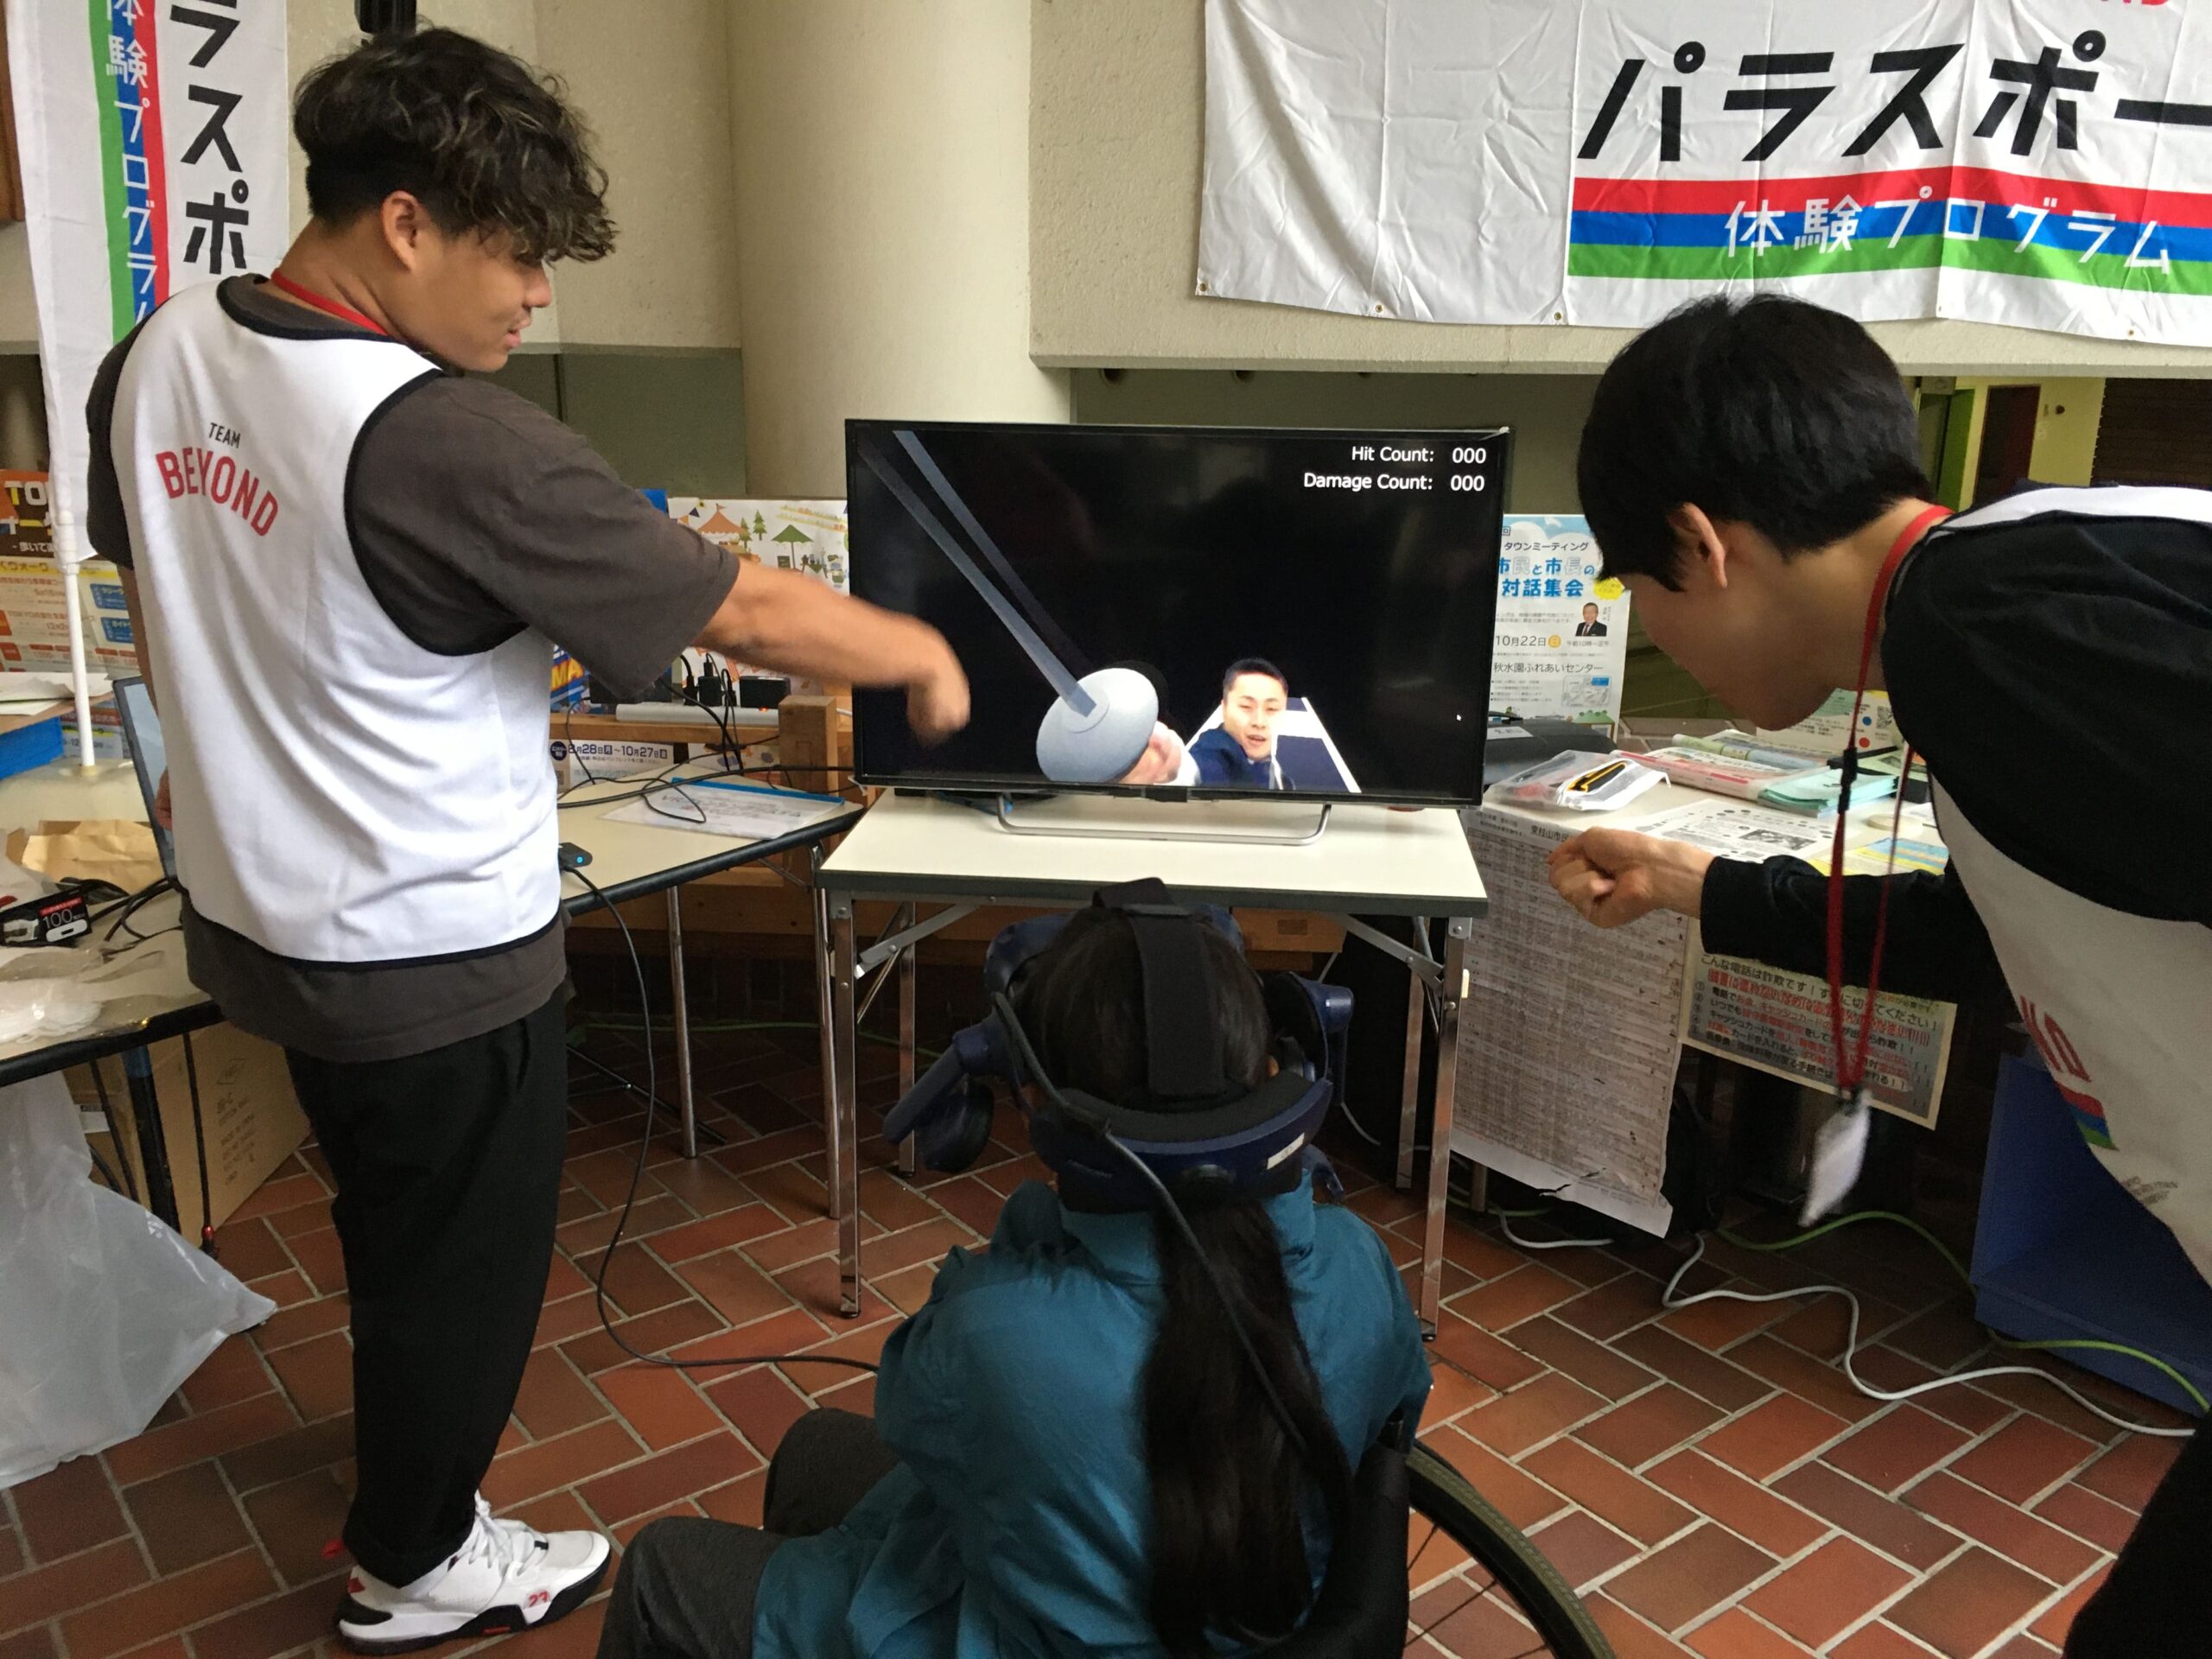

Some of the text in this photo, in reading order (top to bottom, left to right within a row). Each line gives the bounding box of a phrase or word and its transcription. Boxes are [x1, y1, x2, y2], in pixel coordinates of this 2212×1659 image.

[1725, 185, 2170, 275] 体験プログラム
[209, 422, 241, 448] TEAM
[1351, 446, 1486, 464] Hit Count: 000
[156, 446, 278, 537] BEYOND
[1303, 473, 1484, 492] Damage Count: 000
[1503, 542, 1590, 552] タウンミーティング
[1501, 577, 1585, 598] 対話集会
[1492, 662, 1605, 674] 秋水園ふれあいセンター
[42, 908, 73, 929] 100
